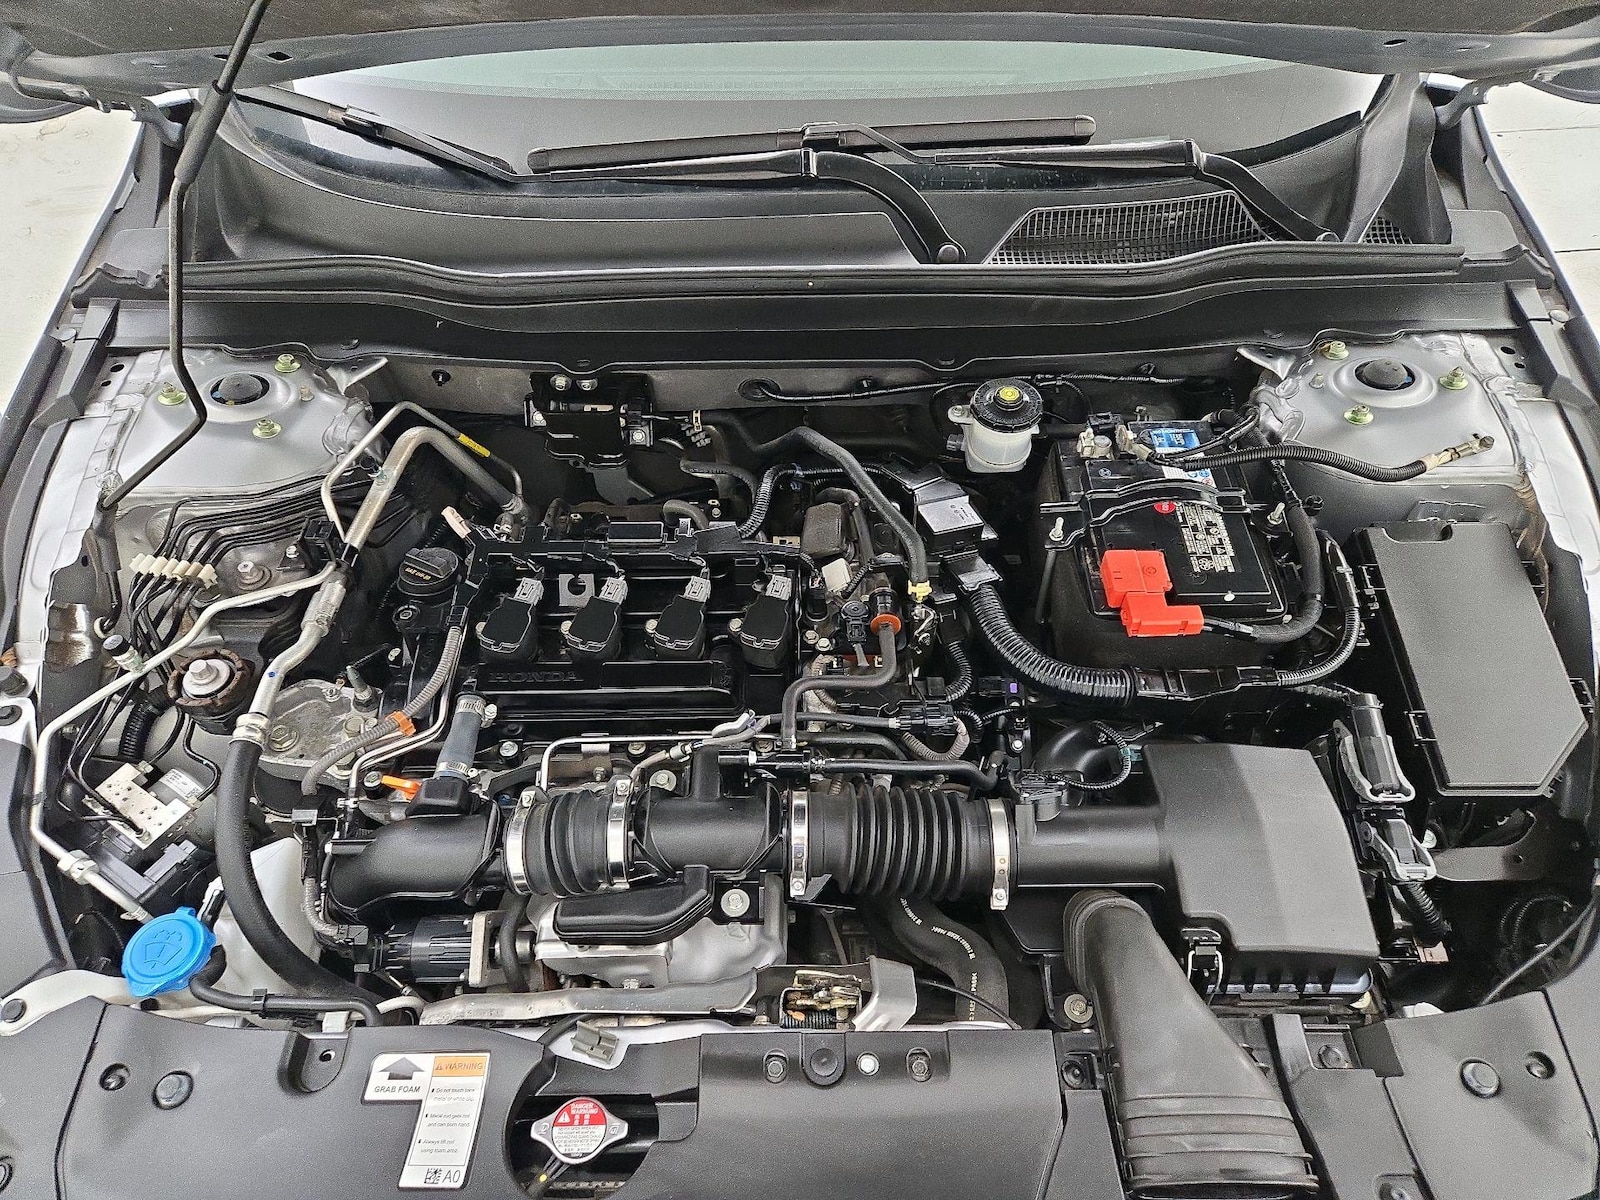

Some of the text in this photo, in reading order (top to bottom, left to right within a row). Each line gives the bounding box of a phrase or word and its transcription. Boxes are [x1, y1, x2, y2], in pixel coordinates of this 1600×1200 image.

[489, 671, 584, 683] HONDA
[445, 1062, 483, 1070] WARNING
[374, 1085, 421, 1093] GRAB FOAM
[442, 1169, 461, 1183] A0
